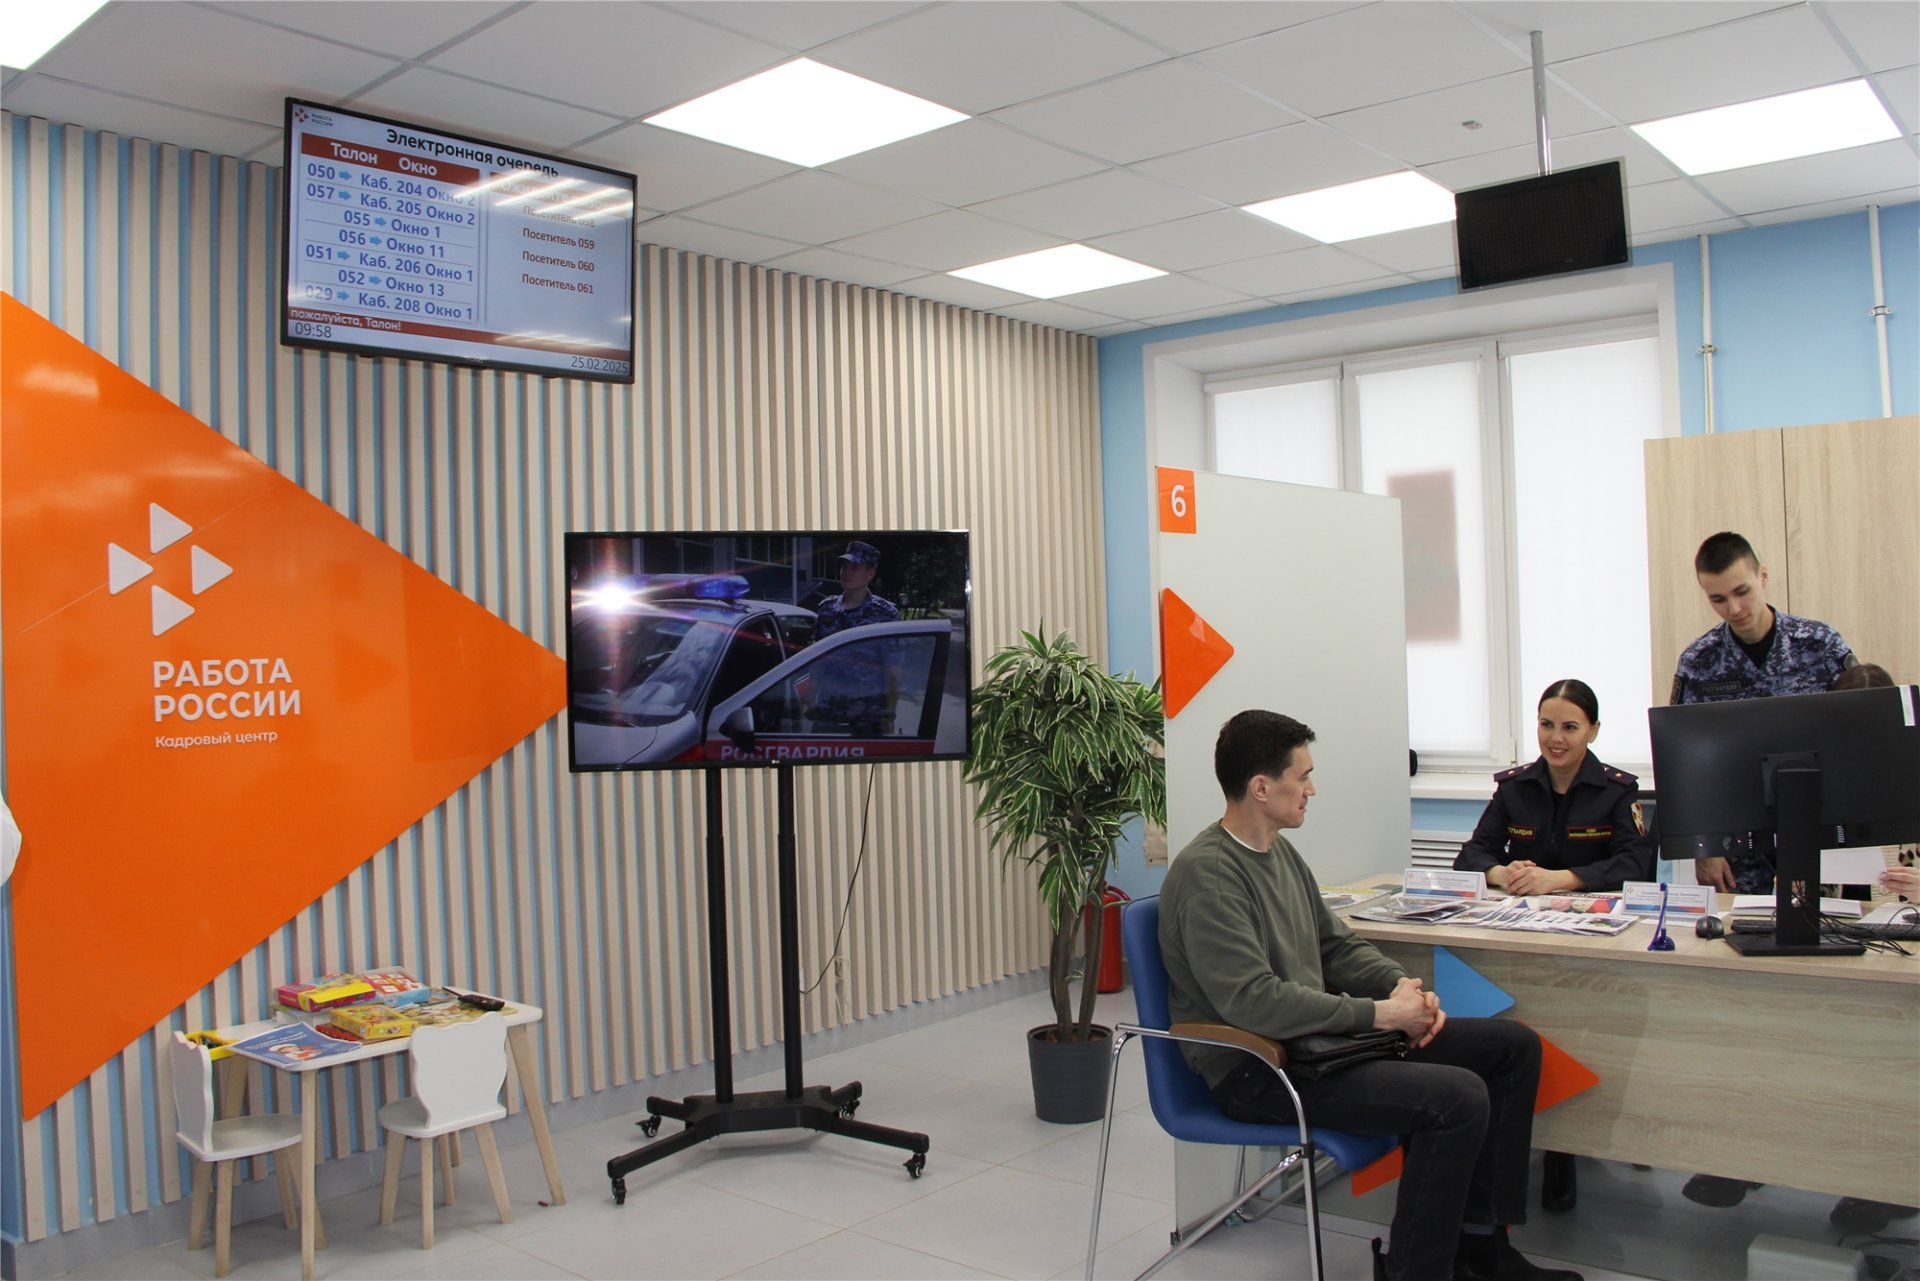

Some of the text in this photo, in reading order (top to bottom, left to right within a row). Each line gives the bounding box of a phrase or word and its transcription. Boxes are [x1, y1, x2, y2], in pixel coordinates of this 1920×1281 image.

[330, 142, 438, 176] Талон Окно
[386, 129, 493, 164] Электронная
[307, 162, 476, 207] 050 Каб. 204 Окно 2
[307, 183, 475, 226] 057 Каб. 205 Окно 2
[344, 210, 441, 239] 055 Окно 1
[523, 227, 596, 250] Посетитель 059
[339, 229, 445, 259] 056 Окно 11
[306, 244, 473, 283] 051 Каб. 206 Окно 1
[522, 250, 595, 273] Посетитель 060
[338, 269, 445, 297] 052 Окно 13
[522, 273, 594, 295] Посетитель 061
[305, 285, 473, 321] 029 Каб. 208 Окно 1
[294, 321, 333, 339] 09:58
[571, 355, 629, 374] 25.02.2025
[1170, 484, 1188, 518] 6
[153, 658, 292, 688] РАБОТА
[154, 690, 300, 722] РОССИИ
[155, 731, 278, 749] Кадровый центр
